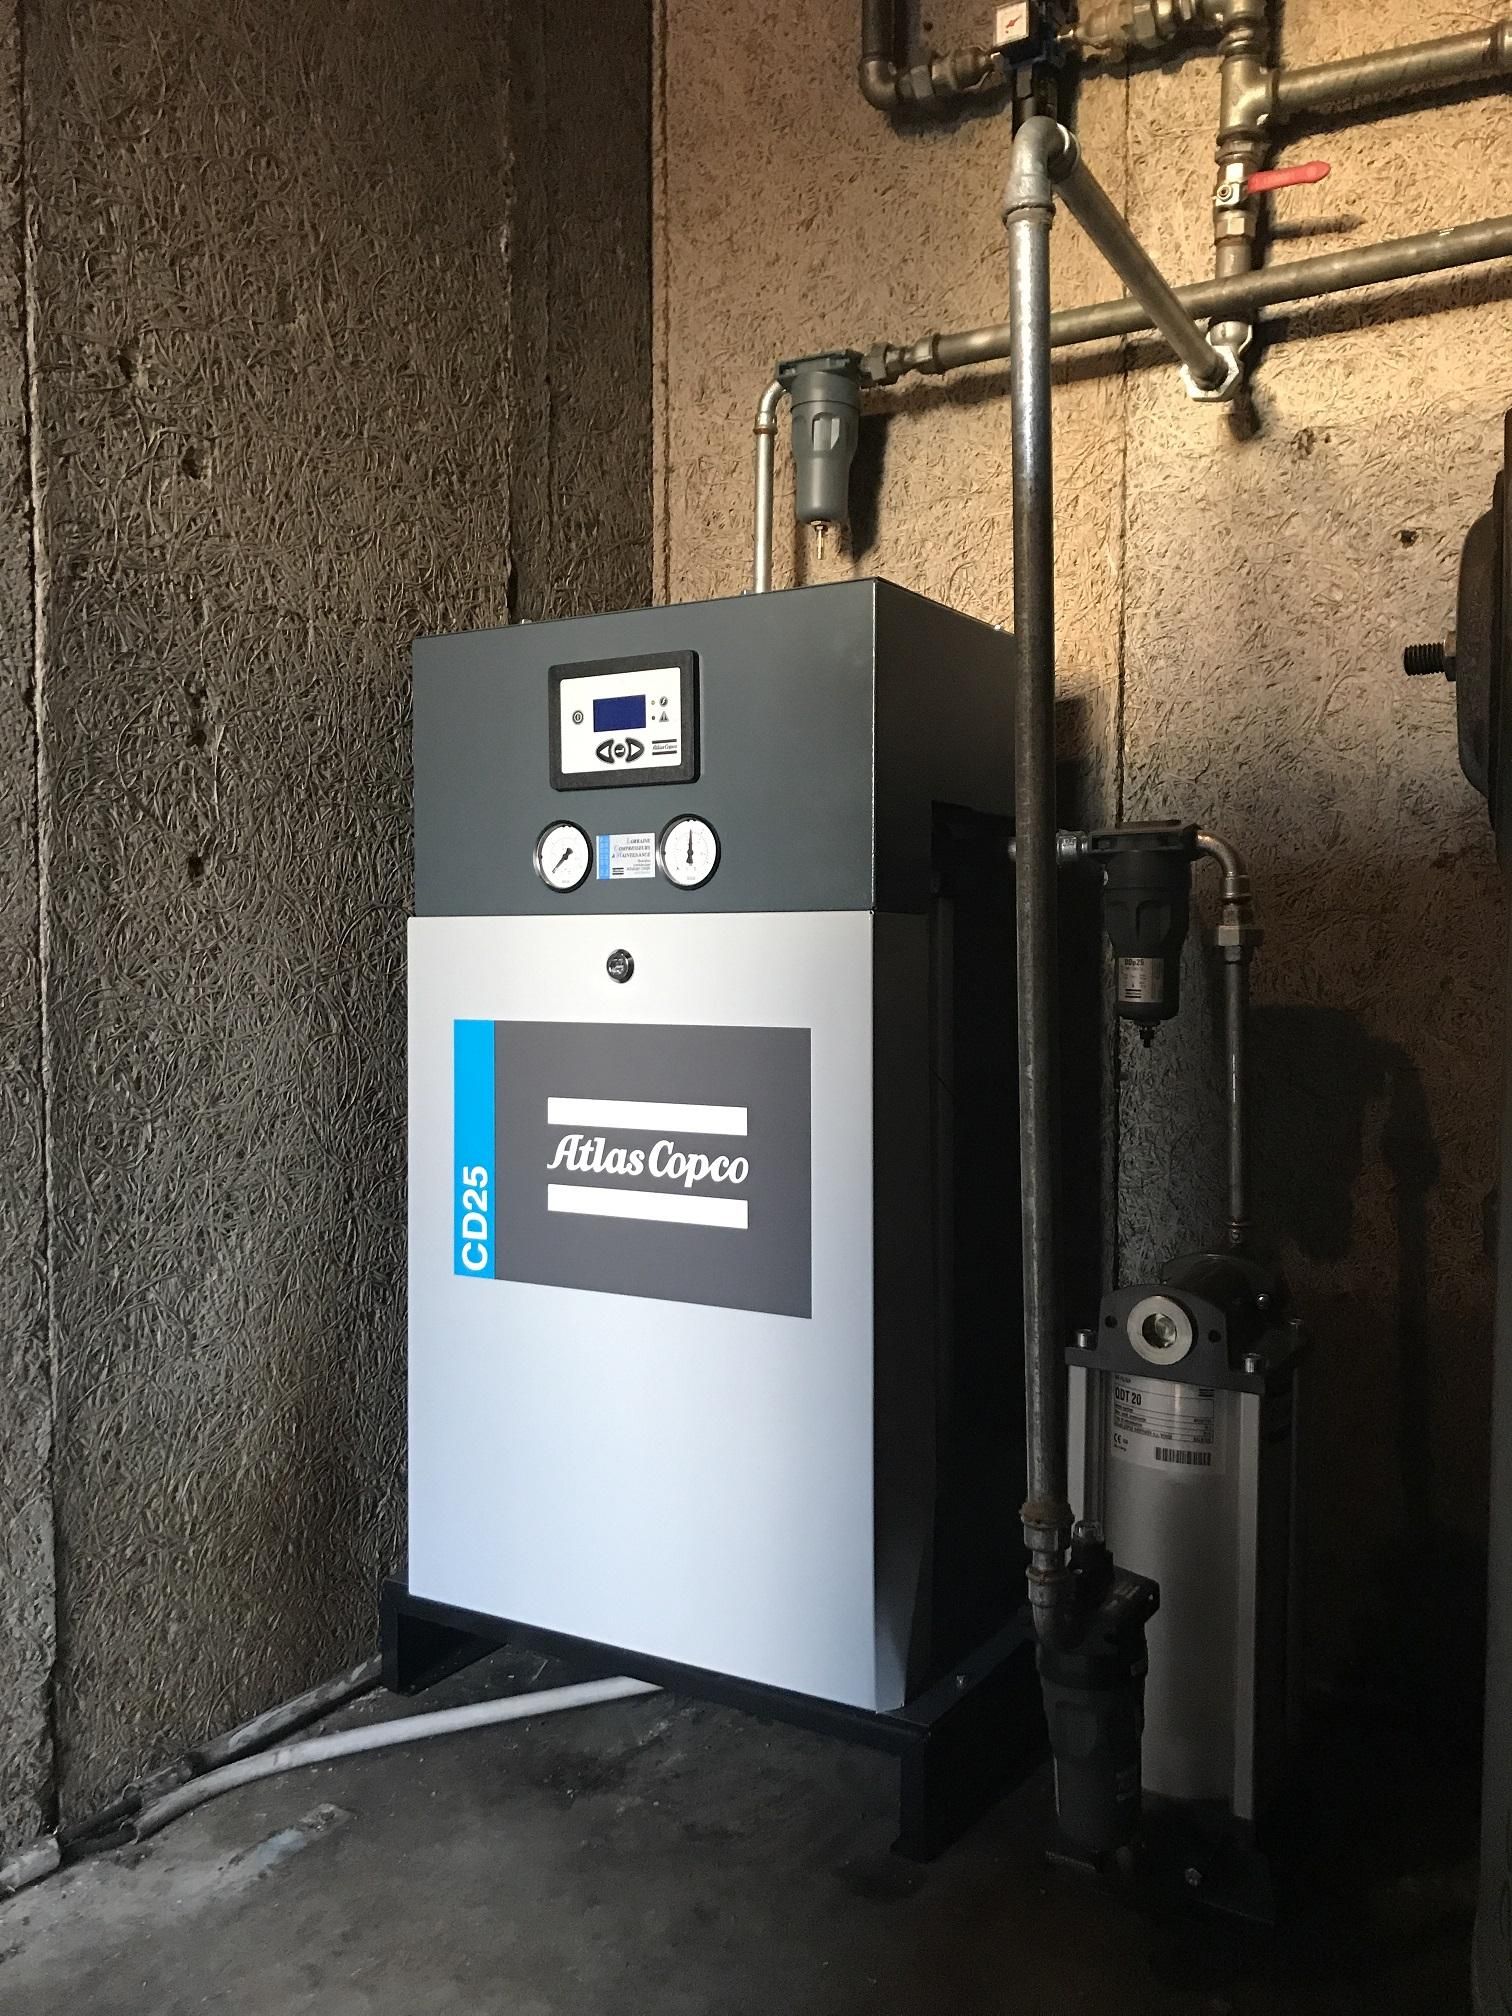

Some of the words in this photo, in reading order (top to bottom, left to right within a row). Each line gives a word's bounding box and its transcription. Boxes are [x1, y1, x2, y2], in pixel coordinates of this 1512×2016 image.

[547, 1134, 646, 1177] Atlas
[648, 1139, 749, 1188] Copco
[461, 1165, 489, 1272] CD25
[1115, 1387, 1130, 1403] QDT
[1131, 1393, 1142, 1406] 20
